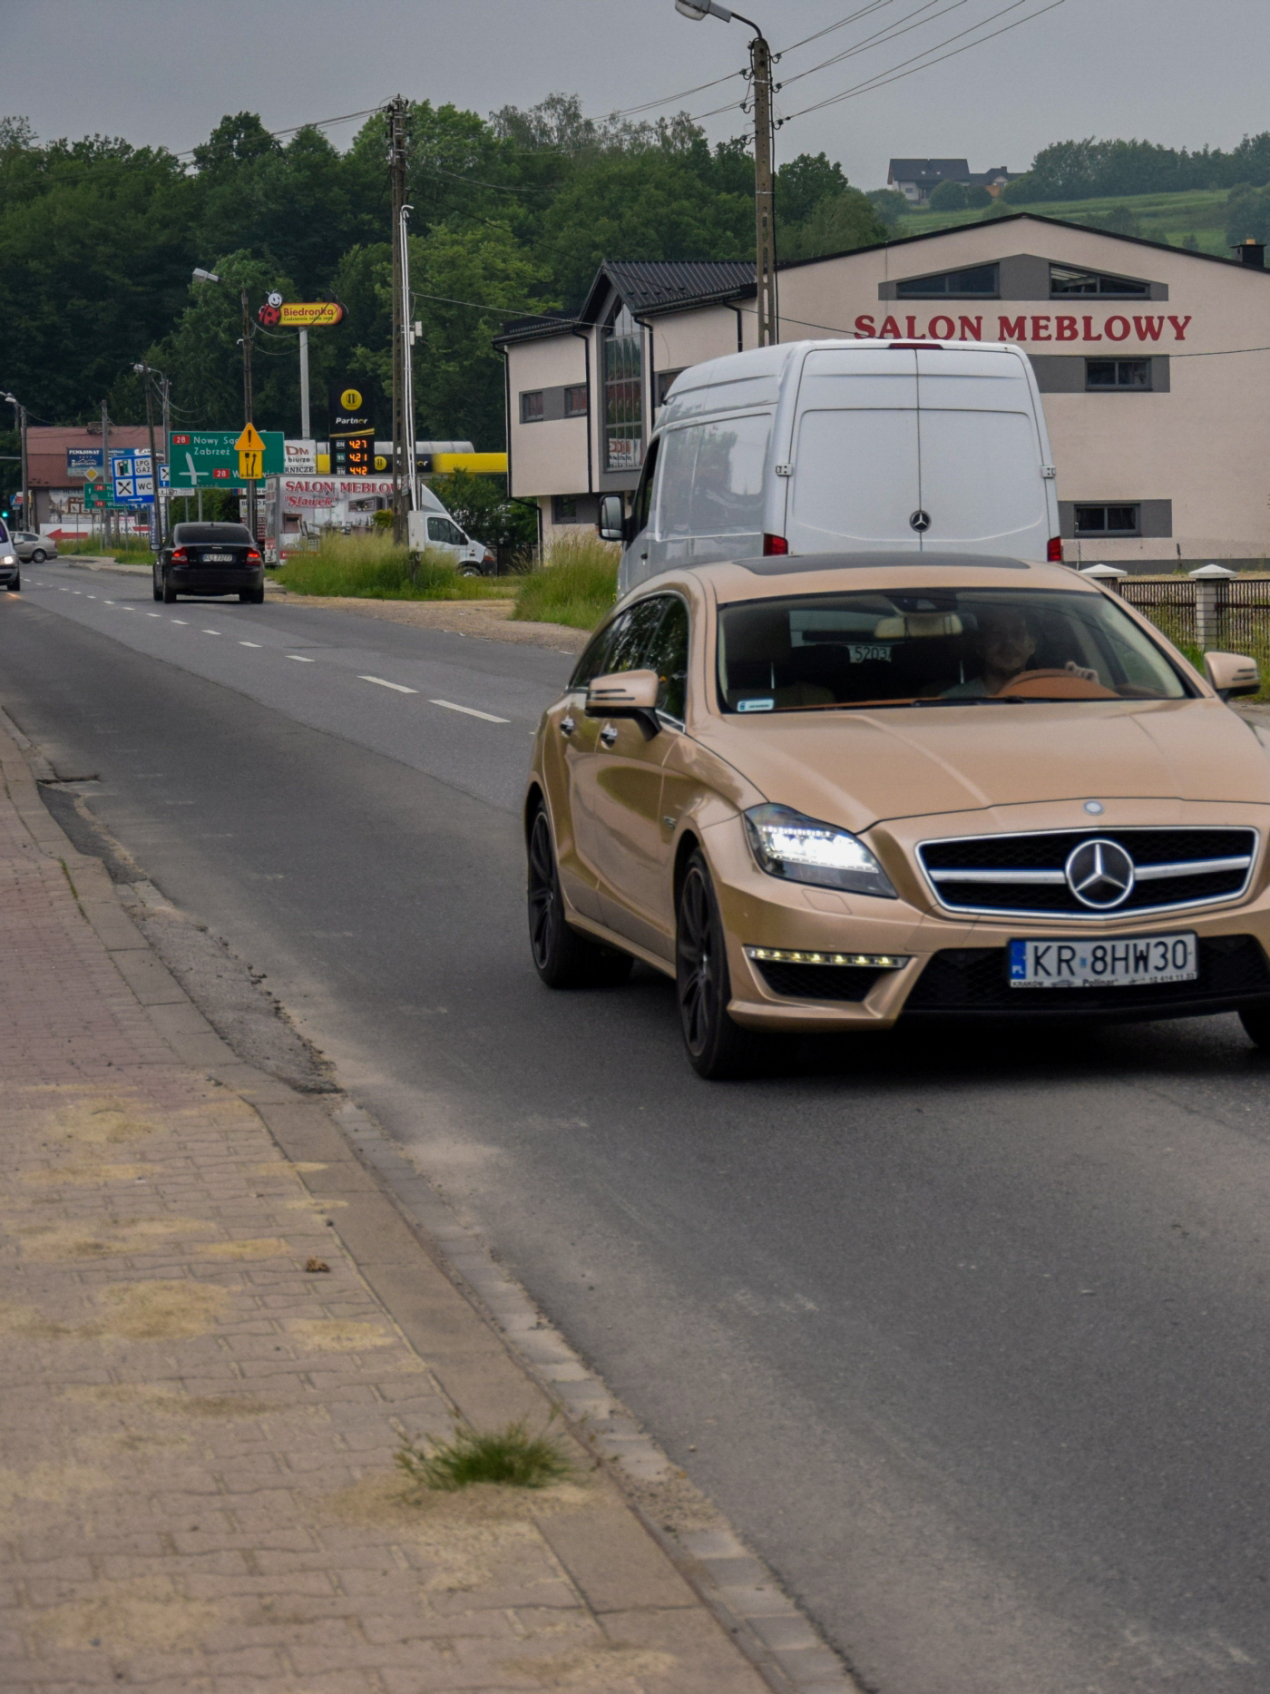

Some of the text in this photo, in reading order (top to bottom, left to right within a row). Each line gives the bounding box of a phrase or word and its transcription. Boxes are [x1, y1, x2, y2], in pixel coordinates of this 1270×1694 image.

[283, 307, 334, 316] Biedronka
[853, 315, 1192, 342] SALON MEBLOWY
[335, 417, 368, 425] Partner
[176, 436, 186, 444] 28
[193, 437, 219, 446] Nowy
[135, 459, 150, 467] LPG
[135, 466, 151, 474] GAZ
[138, 482, 152, 490] WC
[285, 481, 335, 493] SALON
[1033, 939, 1187, 976] KR 8HW30
[1012, 965, 1025, 974] PL
